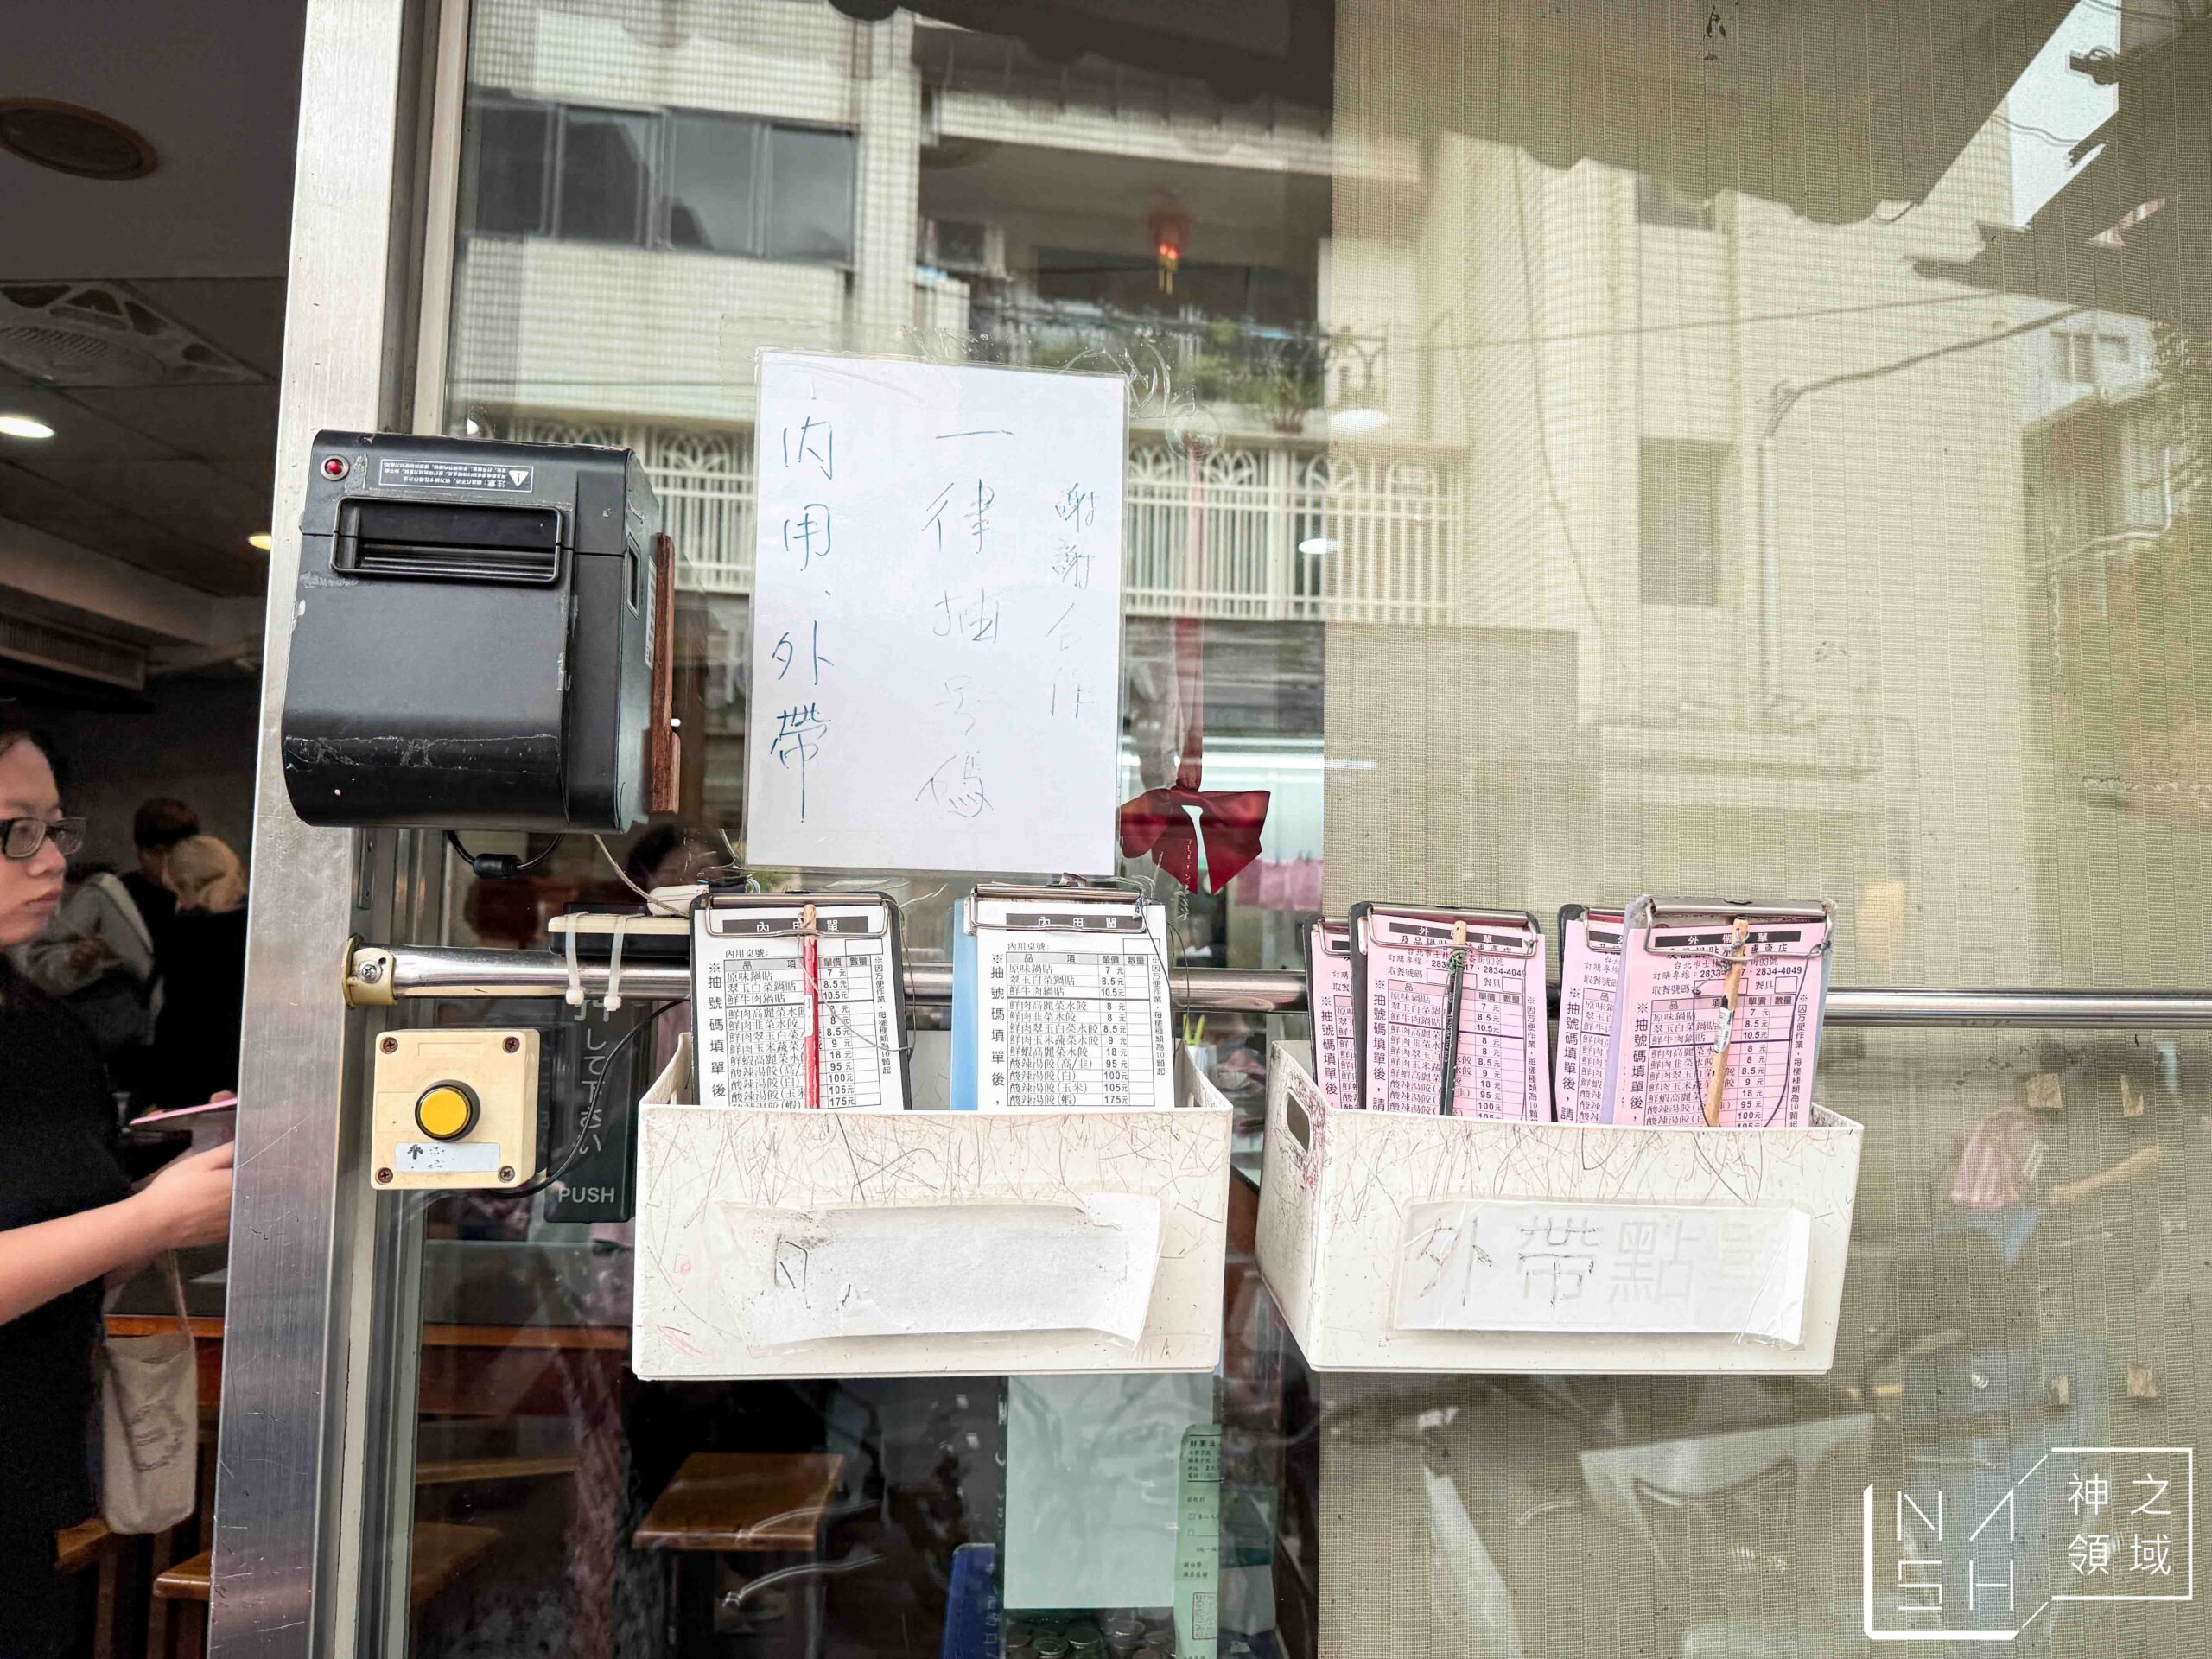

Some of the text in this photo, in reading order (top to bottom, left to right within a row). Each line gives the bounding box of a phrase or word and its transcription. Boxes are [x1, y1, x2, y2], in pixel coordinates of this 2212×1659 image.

[743, 961, 752, 969] 品
[849, 957, 868, 965] 數量
[1103, 955, 1119, 964] 單價
[1009, 964, 1052, 974] 原味鍋貼
[728, 970, 772, 982] 原味鍋貼
[1010, 976, 1075, 986] 翠玉白菜鍋貼
[1009, 987, 1064, 996] 鮮牛肉鍋貼
[1391, 992, 1430, 1003] 原味鍋貼
[728, 993, 785, 1004] 鮮牛肉鍋貼
[1503, 995, 1520, 1003] 數量
[1010, 1001, 1086, 1011] 鮮肉高麗菜水餃
[1391, 1002, 1446, 1015] 翠玉白菜鍋
[730, 1030, 821, 1042] 鮮肉翠玉白菜
[730, 1041, 822, 1054] 鮮肉玉米蔬菜
[1391, 1037, 1440, 1049] 鮮肉韭菜水
[1651, 1046, 1715, 1058] 鮮肉高麗菜水
[731, 1063, 804, 1077] 酸辣湯餃(高/
[732, 1087, 805, 1102] 酸辣湯餃(玉米
[558, 1187, 614, 1204] PUSH
